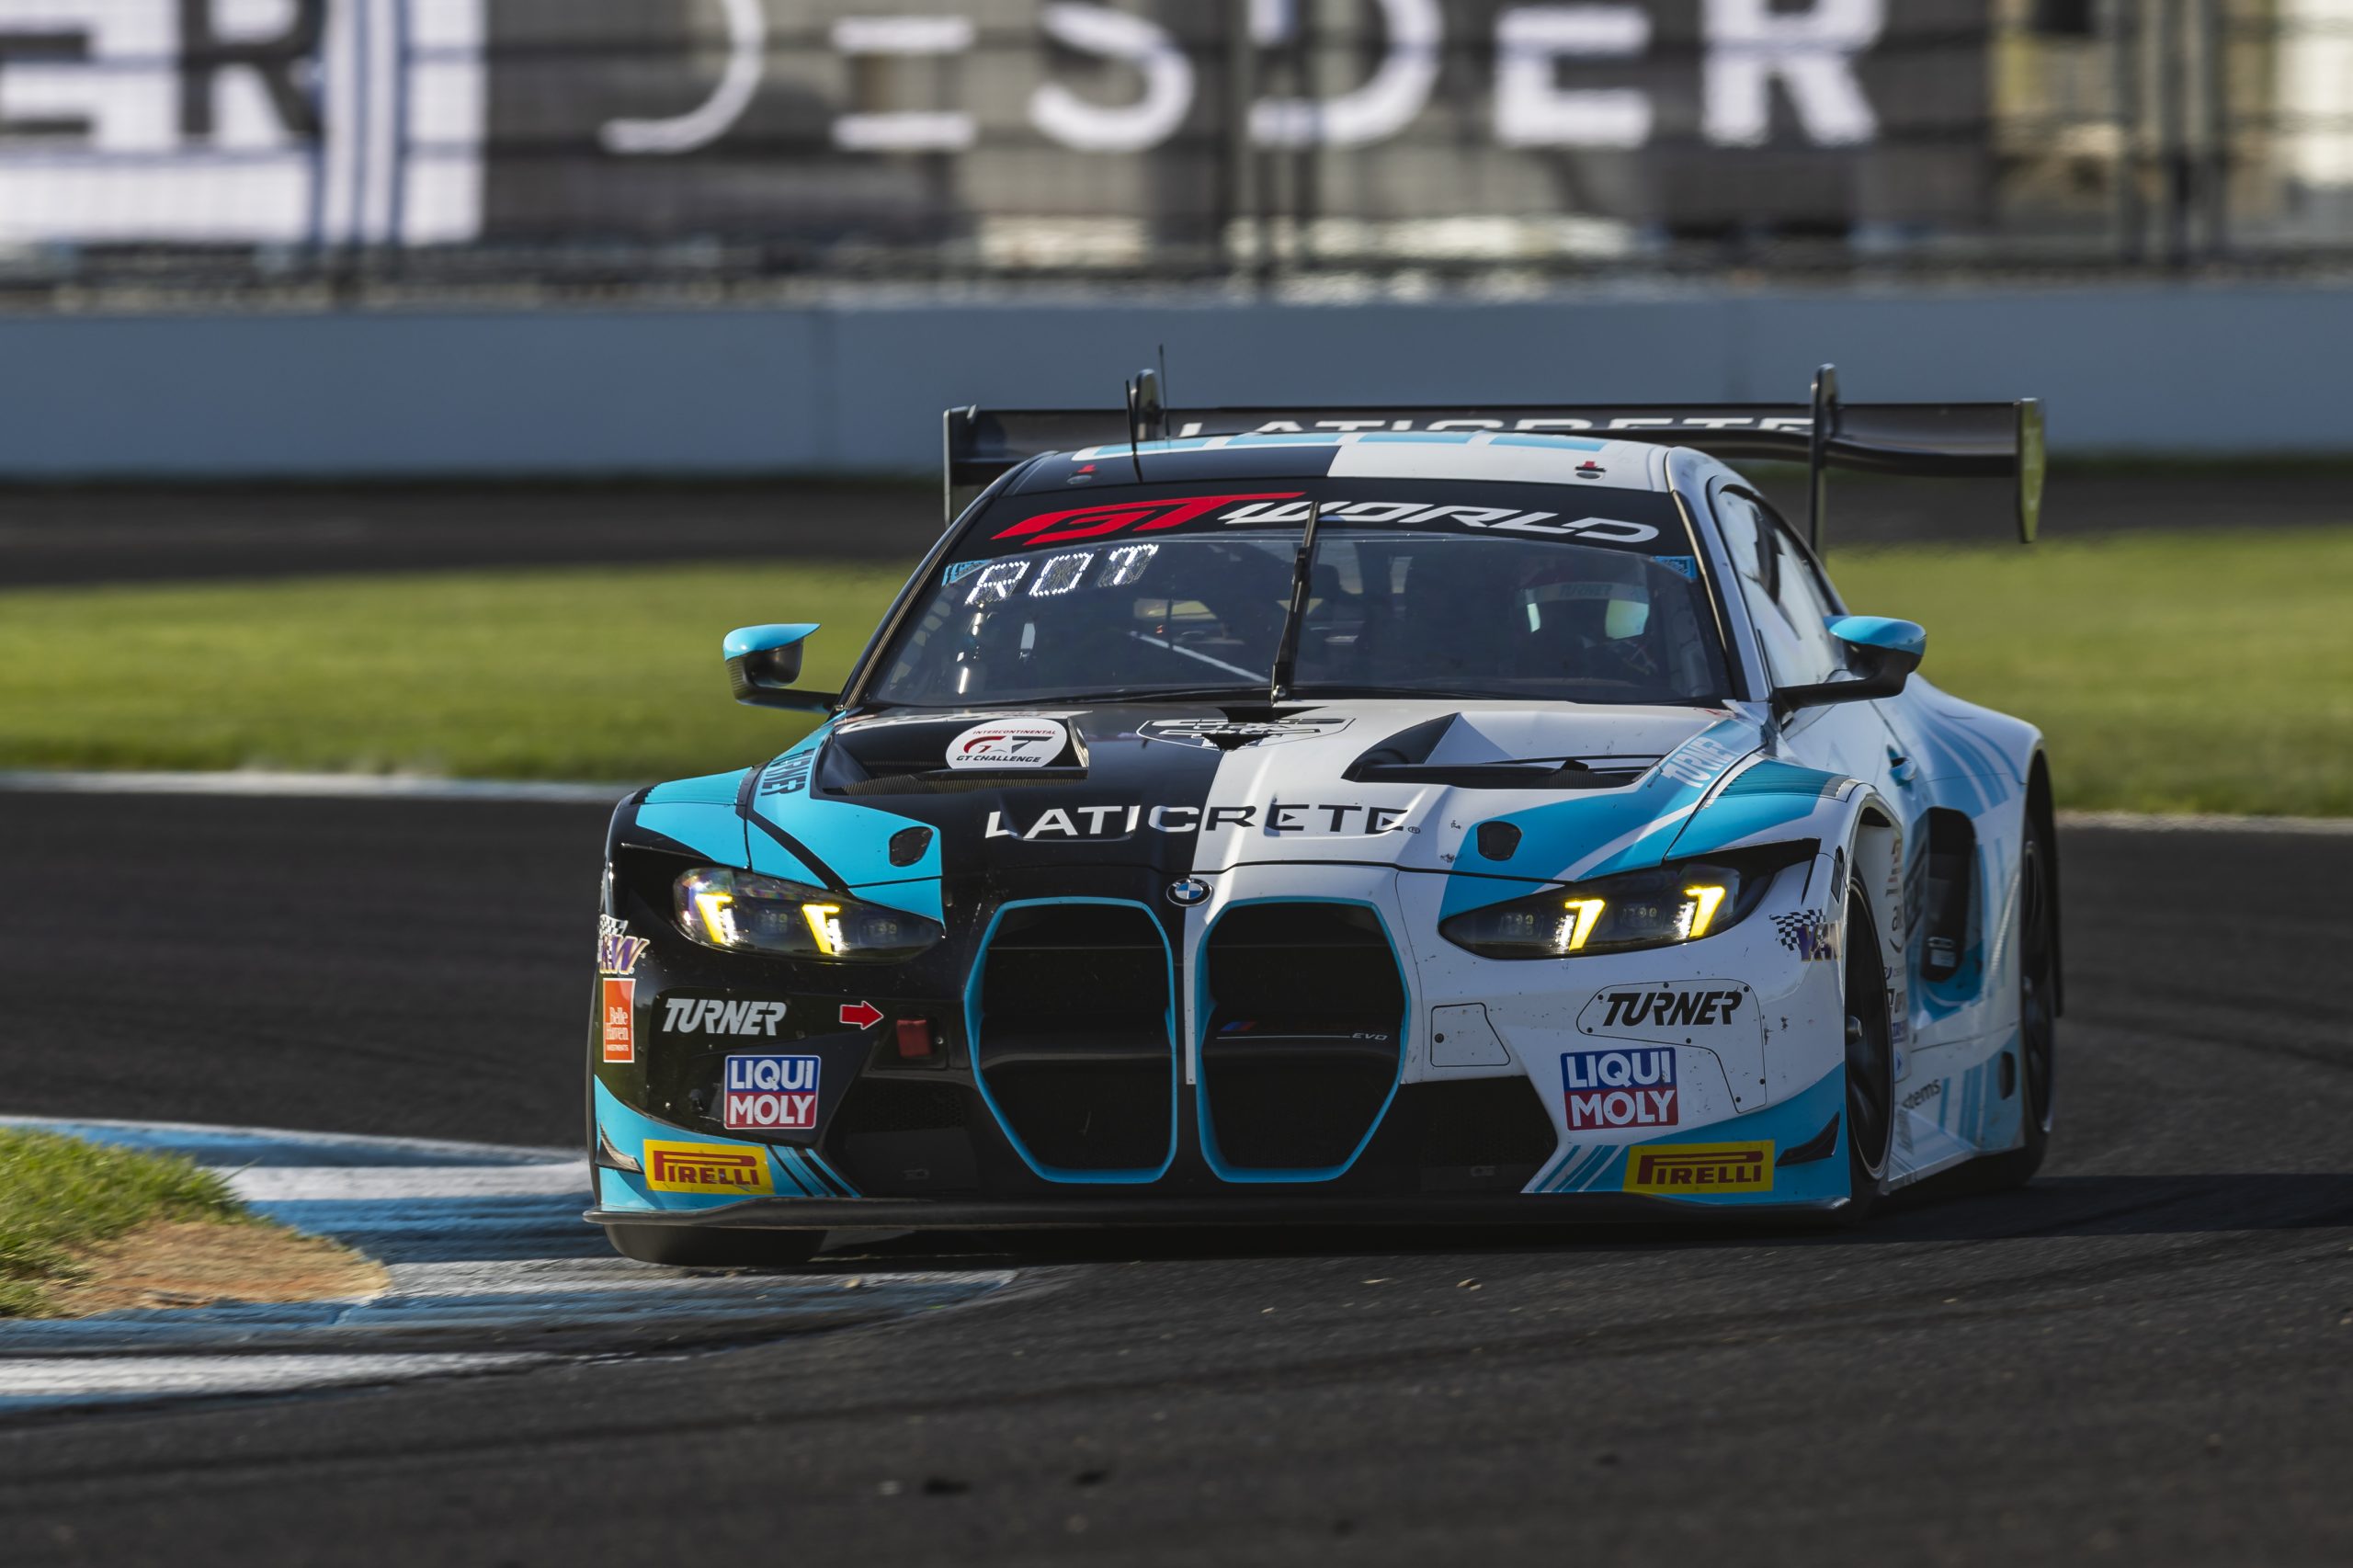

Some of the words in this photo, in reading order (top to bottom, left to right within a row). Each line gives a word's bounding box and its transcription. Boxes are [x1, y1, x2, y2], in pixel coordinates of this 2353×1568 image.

[990, 492, 1307, 546] GT
[1217, 501, 1660, 543] WORLD
[973, 755, 1042, 763] CHALLENGE
[1660, 737, 1739, 789] TURNER
[662, 997, 787, 1037] TURNER
[1603, 991, 1743, 1027] TURNER
[1352, 1032, 1388, 1041] EVO
[730, 1059, 815, 1091] LIQUI
[1566, 1051, 1673, 1088] LIQUI
[730, 1094, 815, 1125] MOLY
[1570, 1089, 1677, 1127] MOLY
[654, 1150, 760, 1186] PIRELLI
[1636, 1150, 1765, 1185] PIRELLI
